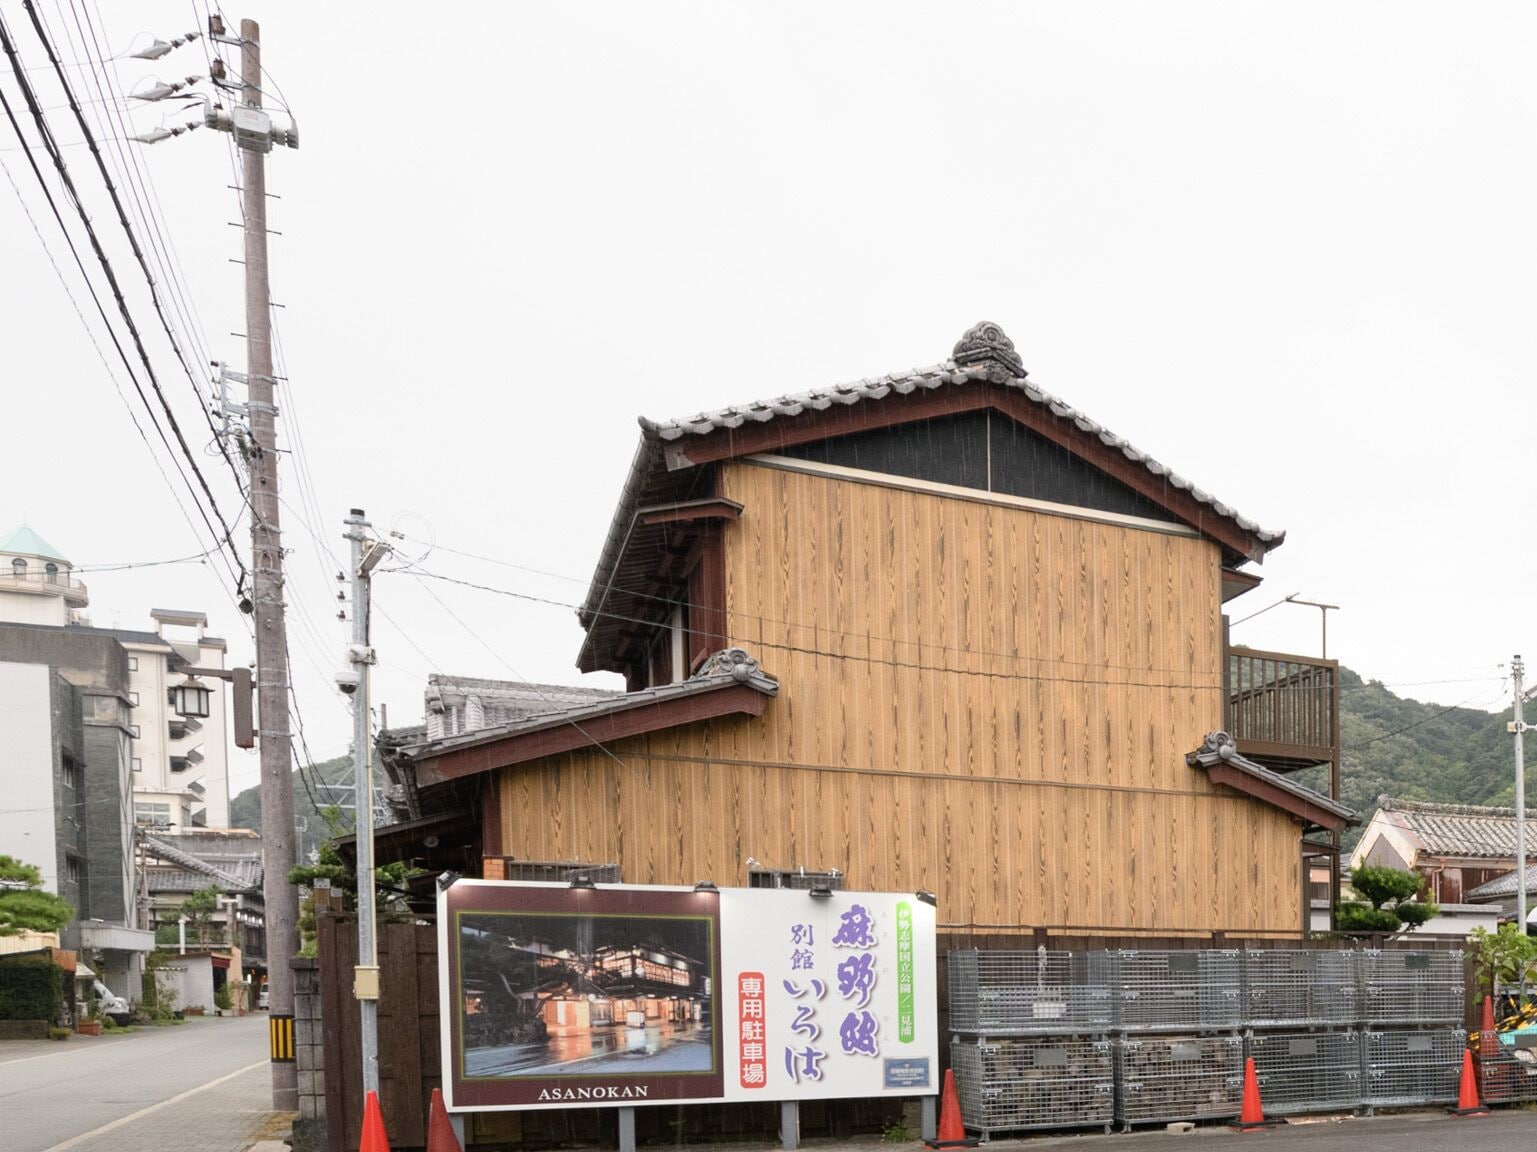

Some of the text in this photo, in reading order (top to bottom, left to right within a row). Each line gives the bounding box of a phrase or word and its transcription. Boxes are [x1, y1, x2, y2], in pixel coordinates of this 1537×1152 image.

[741, 977, 765, 1084] 専用駐車場
[783, 924, 826, 1082] 別館 いろは
[537, 1085, 649, 1101] ASANOKAN
